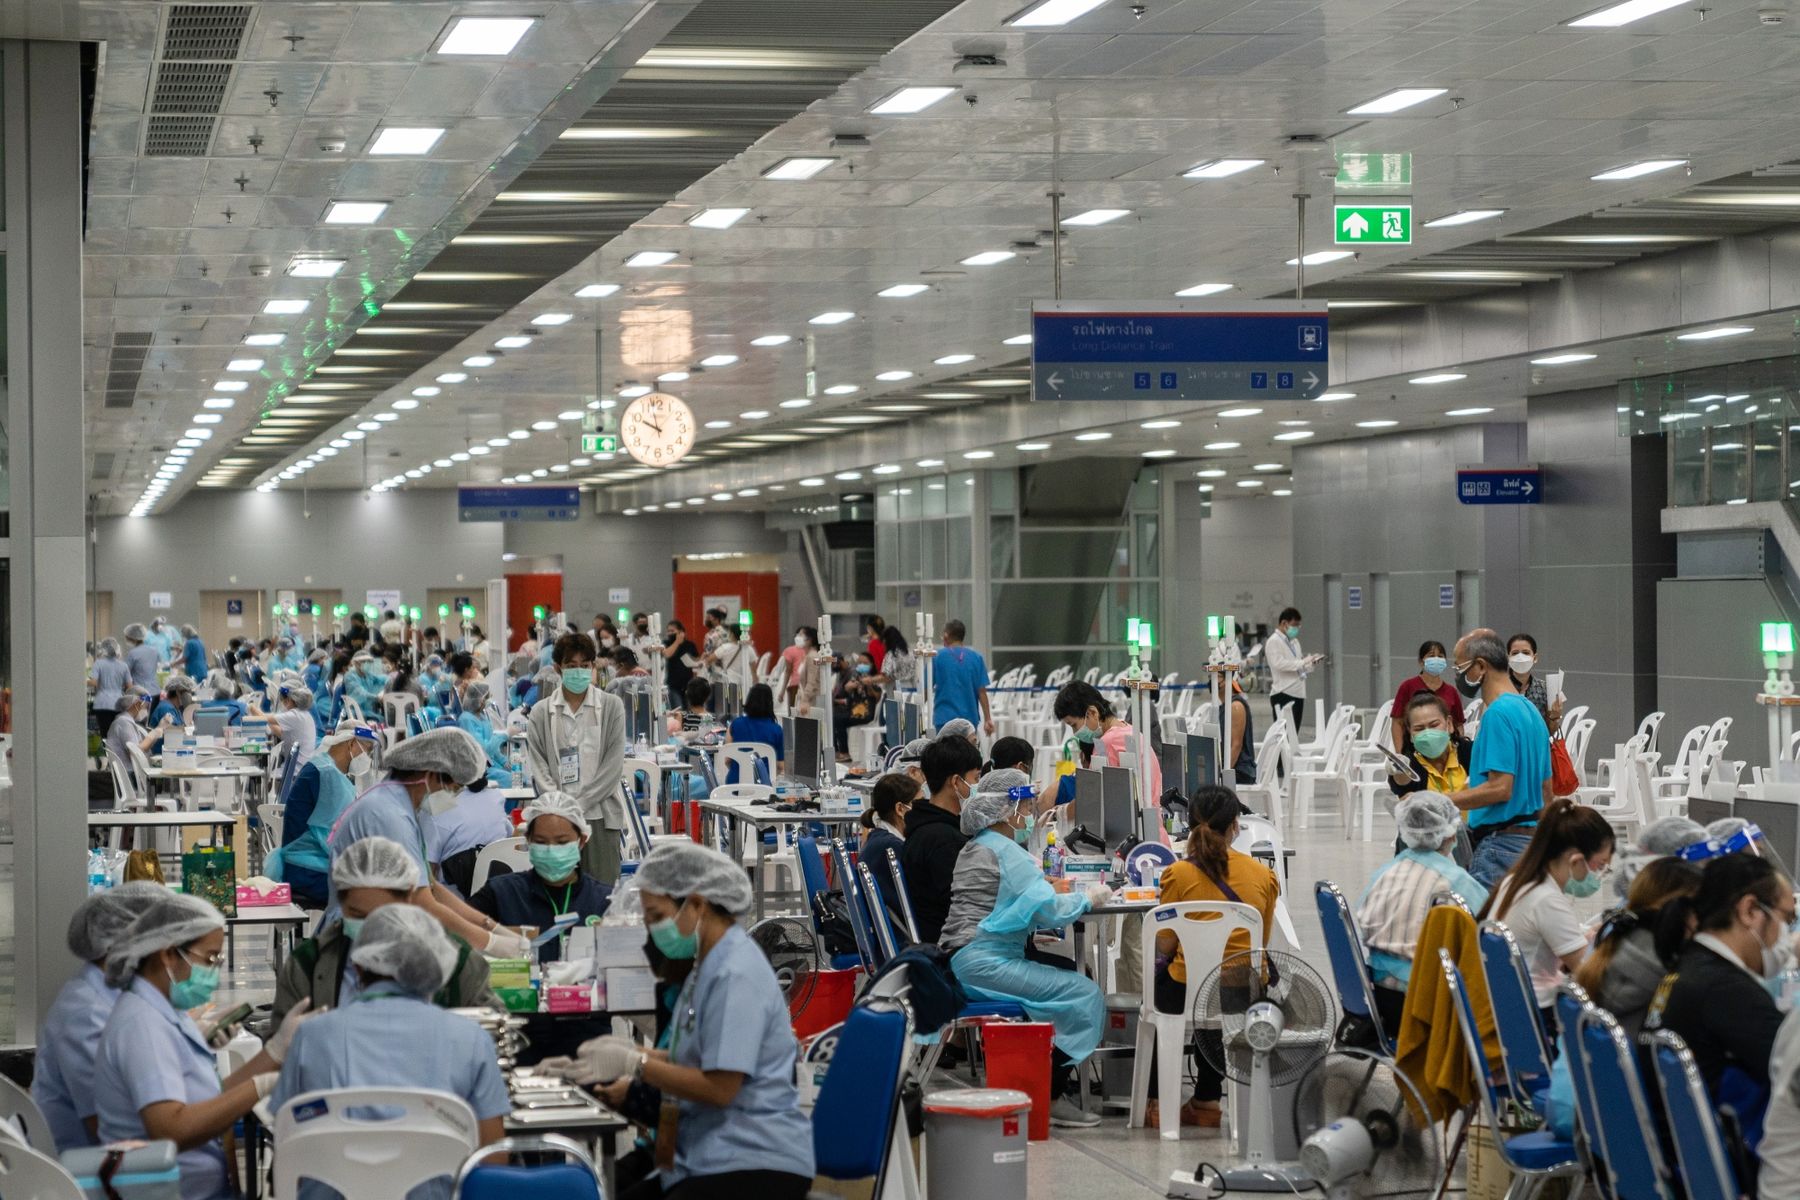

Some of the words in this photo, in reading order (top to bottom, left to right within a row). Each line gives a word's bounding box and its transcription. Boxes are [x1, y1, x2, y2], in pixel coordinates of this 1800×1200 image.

[1072, 320, 1153, 336] รถไฟทางไกล
[1072, 341, 1097, 352] Long
[1101, 340, 1145, 351] Distance
[1150, 340, 1174, 351] Train
[1138, 376, 1146, 386] 5
[1164, 376, 1173, 386] 6
[1255, 376, 1263, 386] 7
[1281, 375, 1289, 386] 8
[641, 402, 650, 413] 11
[631, 412, 642, 423] 10
[675, 411, 683, 421] 2
[628, 425, 636, 435] 9
[679, 423, 686, 434] 3
[633, 436, 641, 447] 8
[675, 436, 682, 445] 4
[643, 445, 650, 455] 7
[654, 448, 662, 458] 6
[666, 444, 674, 454] 5
[813, 1036, 839, 1062] 8
